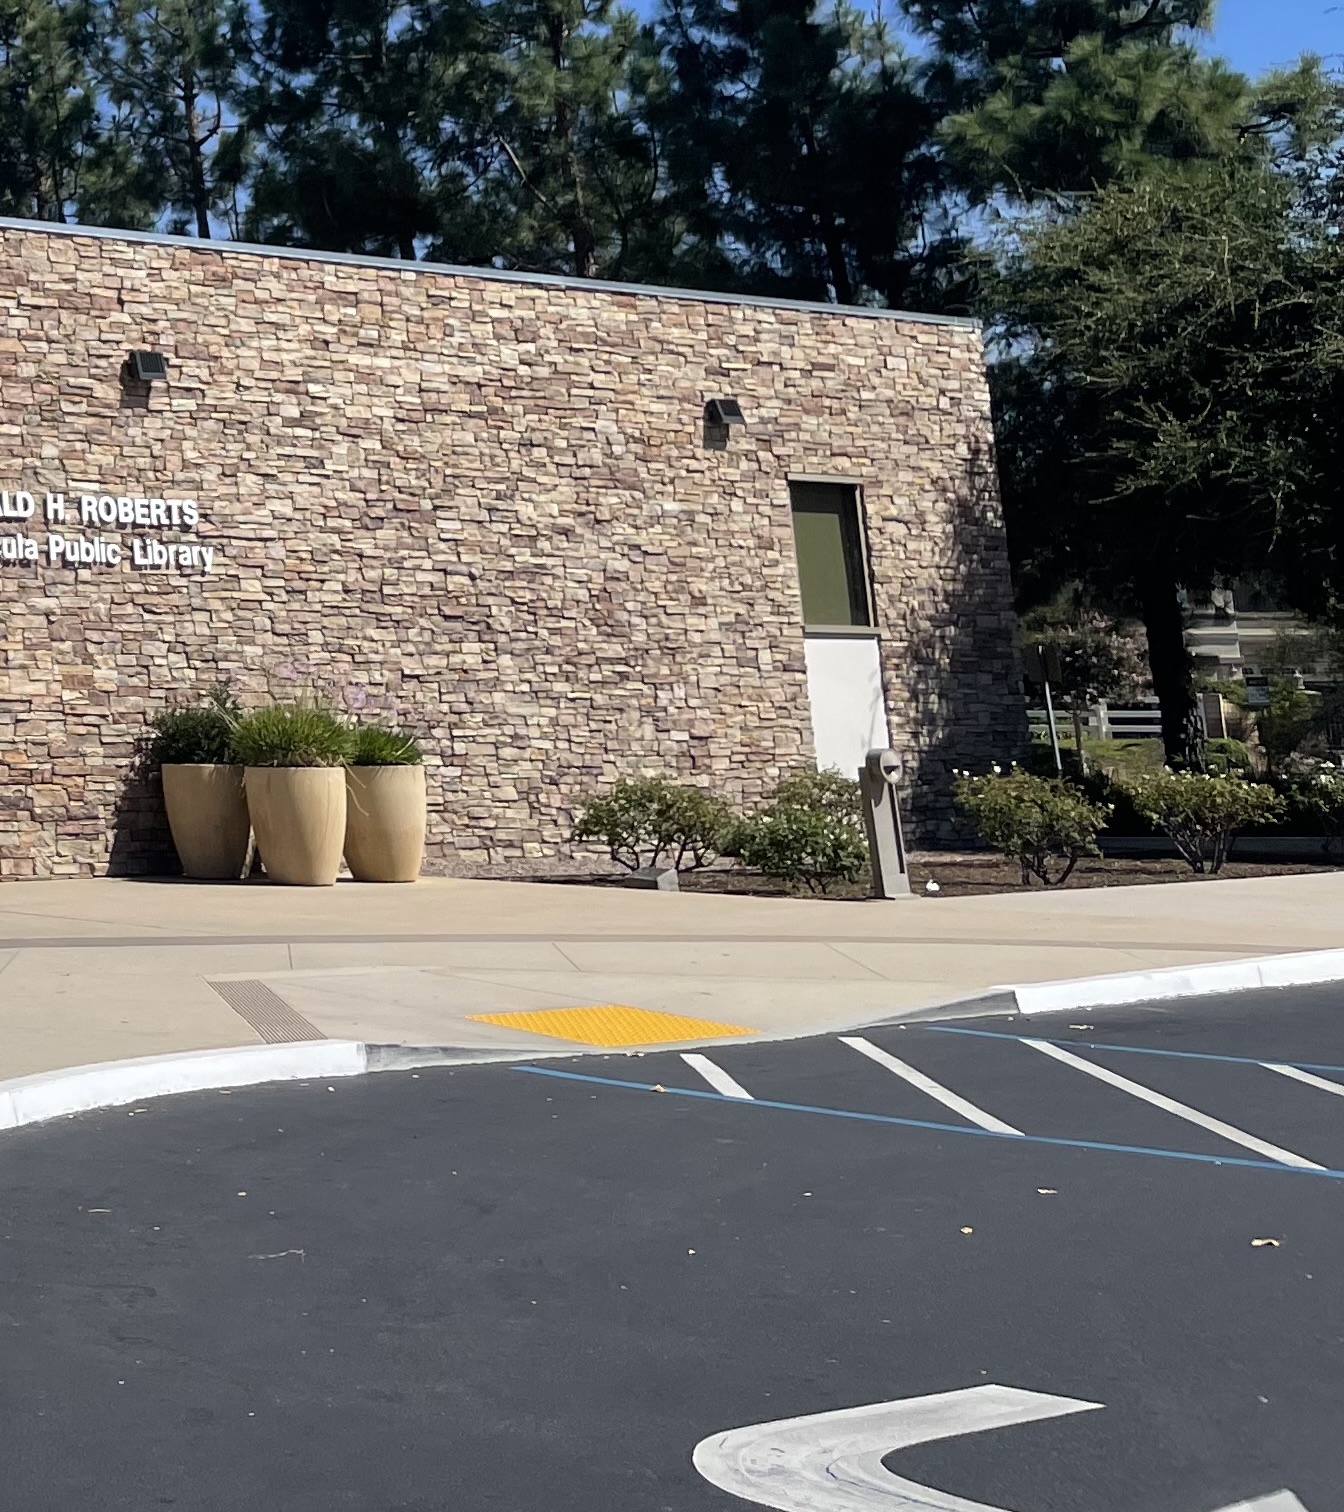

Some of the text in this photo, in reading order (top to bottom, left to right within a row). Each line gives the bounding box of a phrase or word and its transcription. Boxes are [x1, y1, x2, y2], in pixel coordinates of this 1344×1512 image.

[46, 493, 71, 522] H.
[81, 495, 199, 526] ROBERTS
[47, 534, 122, 565] Public
[133, 538, 213, 572] Library
